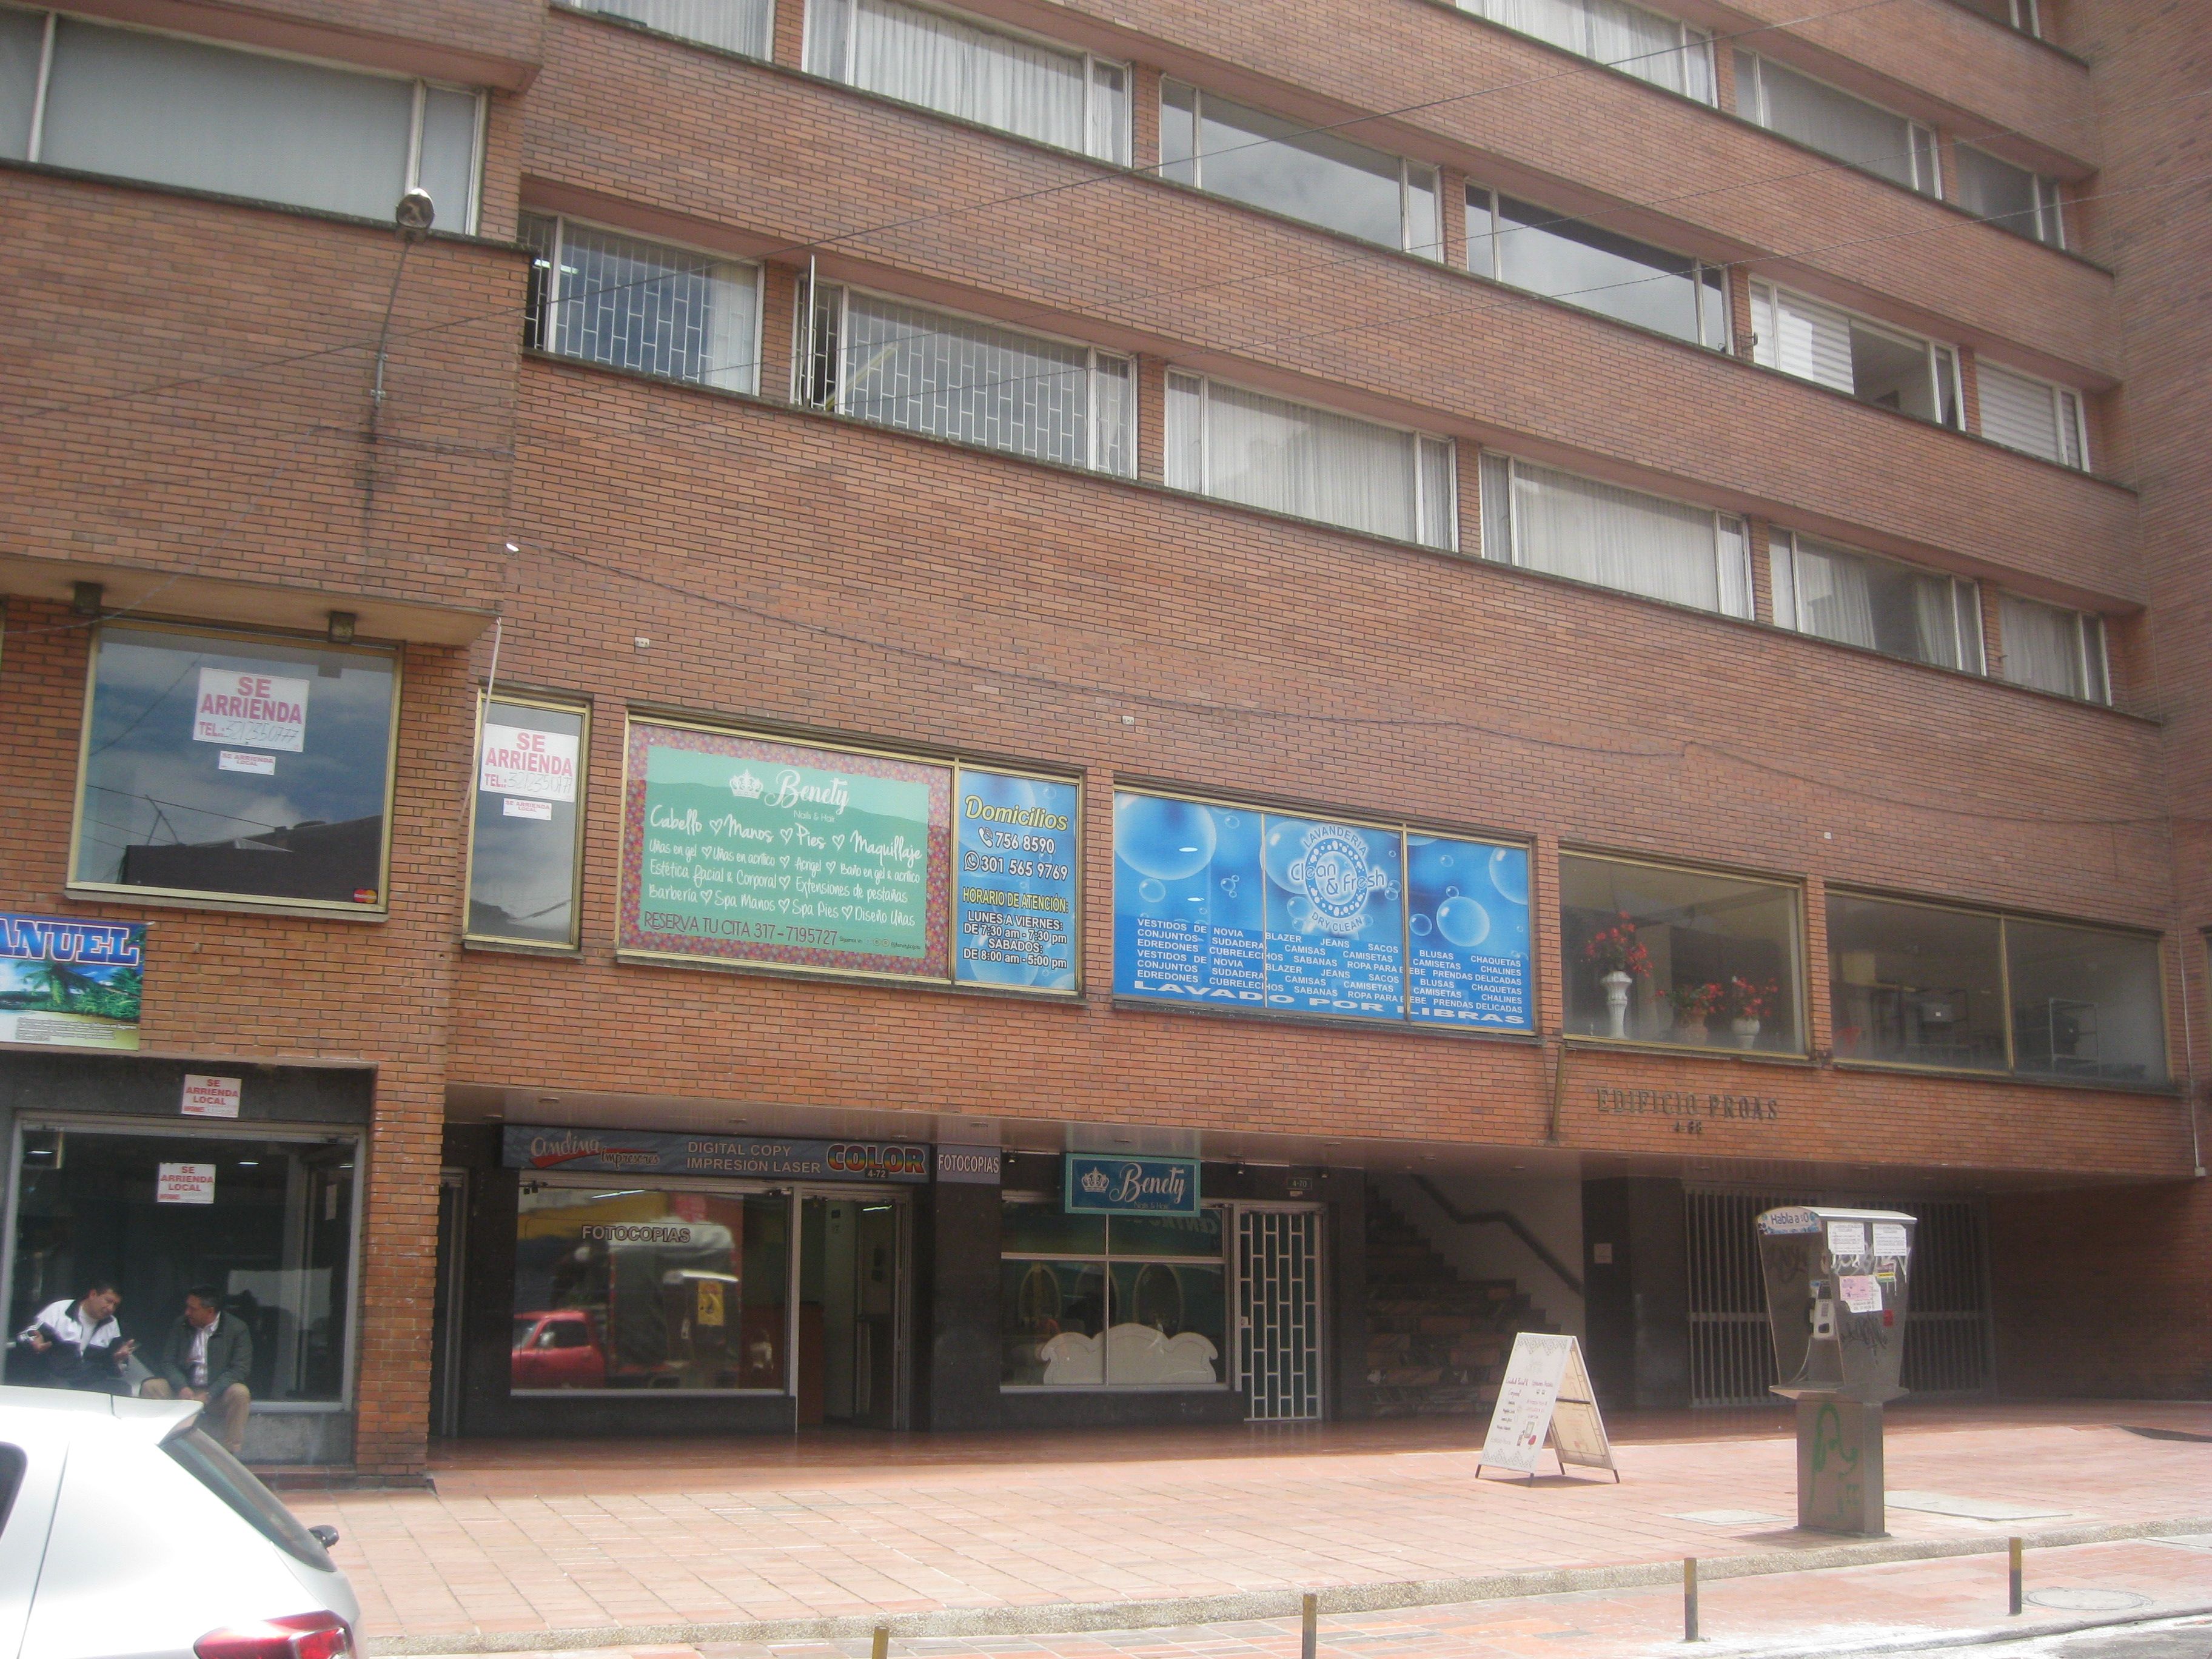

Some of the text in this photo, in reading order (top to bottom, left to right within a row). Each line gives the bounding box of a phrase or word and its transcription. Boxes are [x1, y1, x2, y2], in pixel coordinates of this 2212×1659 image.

[237, 677, 272, 698] SE
[200, 693, 302, 724] ARRIENDA
[517, 732, 545, 752] SE
[485, 747, 572, 777] ARRIENDA
[764, 769, 849, 815] Benety
[965, 795, 1068, 831] Domicilios
[650, 805, 922, 868] Cabello Manos Pies Maquillaje
[995, 831, 1055, 854] 756 8590
[1303, 826, 1367, 856] LAVANDERIA
[649, 839, 671, 854] Uñas
[673, 845, 683, 854] en
[685, 844, 697, 863] gel
[713, 846, 734, 861] Uñas
[736, 853, 745, 862] en
[840, 863, 862, 877] Baño
[863, 868, 873, 878] en
[874, 867, 885, 884] gel
[980, 855, 1068, 881] 301 565 9769
[1291, 863, 1336, 880] Clean
[650, 859, 689, 878] Estética
[737, 869, 777, 890] Corporal
[796, 876, 850, 898] Extensiones
[853, 883, 864, 899] de
[866, 887, 908, 903] pestañas
[1326, 878, 1339, 895] &
[649, 883, 916, 926] Barbería Spa Manos Spa Pies Diseño Uñas
[962, 886, 1069, 913] HORARIO DE ATENCIÓN:
[644, 911, 699, 933] RESERVA
[702, 917, 719, 933] TU
[722, 920, 751, 937] CITA
[754, 923, 776, 939] 317
[786, 926, 837, 945] 7195727
[964, 922, 1067, 945] DE 7:30 am 7:30 pm
[968, 910, 1063, 931] LUNES A VIERNES:
[1312, 912, 1363, 932] DRY CLEAN
[988, 937, 1043, 954] SABADOS:
[1137, 919, 1521, 967] VESTIDOS DE NOVIA BLAZER JEANS SACOS BLUSAS CHAQUETAS
[1138, 929, 1198, 942] CONJUNTOS
[1285, 944, 1326, 956] CAMISAS
[1342, 951, 1393, 963] CAMISETAS
[1413, 958, 1461, 970] CAMISETAS
[1480, 965, 1521, 976] CHALINES
[963, 948, 1067, 970] DE 8:00 am 5:00 pm
[1137, 949, 1522, 995] VESTIDOS DE NOVIA BLAZER JEANS SACOS BLUSAS CHAQUETAS
[1138, 939, 1199, 953] EDREDONES
[1209, 947, 1284, 961] CUBRELECHOS
[1293, 955, 1338, 967] SABANAS
[1347, 960, 1372, 970] ROPA
[1373, 964, 1396, 973] PARA
[1433, 970, 1473, 980] PRENDAS
[1475, 974, 1521, 985] DELICADAS
[1137, 959, 1198, 973] CONJUNTOS
[1285, 975, 1327, 986] CAMISAS
[1343, 980, 1393, 993] CAMISETAS
[1413, 987, 1461, 998] CAMISETAS
[1481, 994, 1522, 1004] CHALINES
[1137, 970, 1199, 983] EDREDONES
[1209, 977, 1284, 992] CUBRELECHOS
[1294, 986, 1338, 997] SABANAS
[1348, 991, 1372, 1001] ROPA
[1374, 993, 1398, 1003] PARA
[1433, 998, 1473, 1009] PRENDAS
[1476, 1002, 1523, 1013] DELICADAS
[1134, 980, 1524, 1024] LAVADO POR LIBRAS
[186, 1087, 239, 1097] ARRIENDA
[207, 1079, 221, 1087] SE
[193, 1096, 226, 1105] LOCAL
[1597, 1088, 1778, 1120] EDIFICIO PROAS
[688, 1141, 791, 1157] DIGITAL COPY
[826, 1143, 927, 1175] COLOR
[686, 1158, 820, 1173] IMPRESIÓN LASER
[938, 1154, 1000, 1174] FOTOCOPIAS
[161, 1175, 213, 1183] ARRIENDA
[1109, 1162, 1186, 1204] Benety
[1771, 1212, 1794, 1225] Habla
[581, 1224, 691, 1243] FOTOCOPIAS
